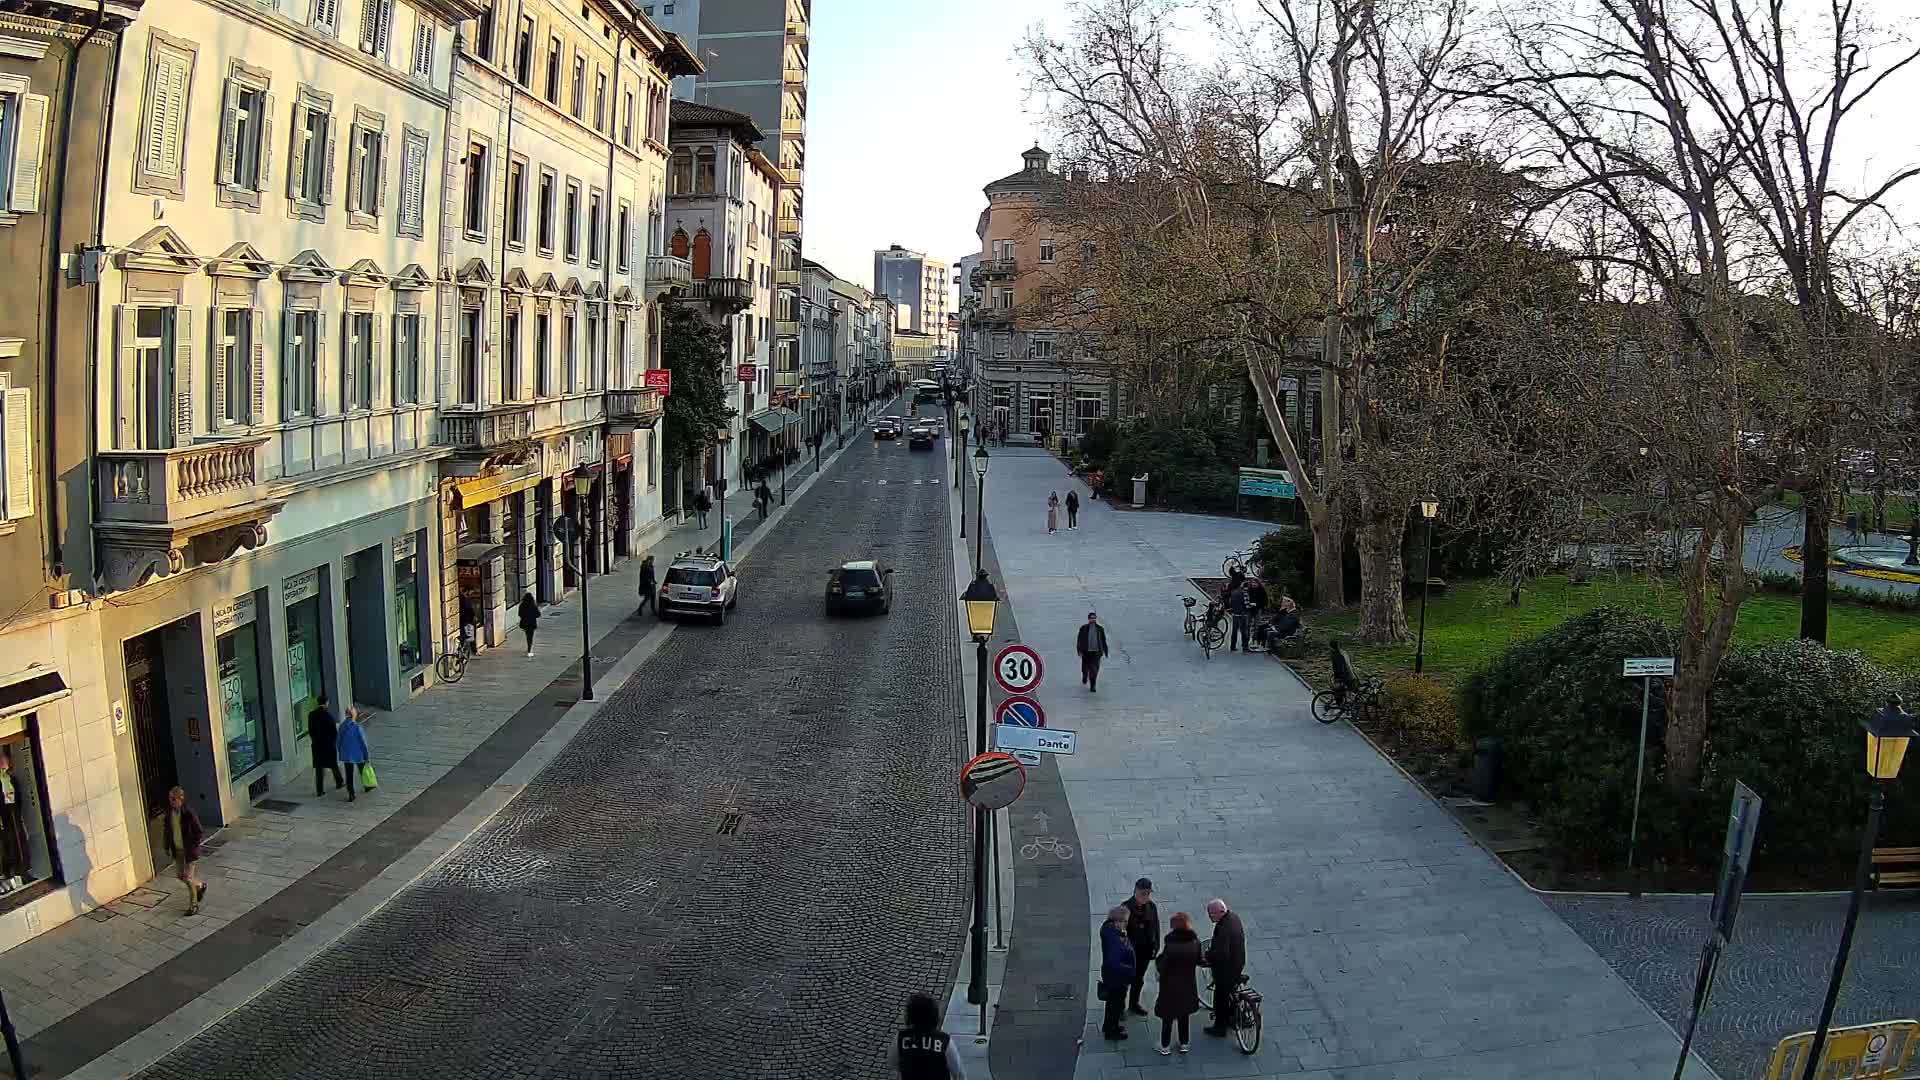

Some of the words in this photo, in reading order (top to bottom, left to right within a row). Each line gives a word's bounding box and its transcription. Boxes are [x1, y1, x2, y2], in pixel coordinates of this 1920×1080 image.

[1005, 658, 1032, 680] 30
[221, 678, 240, 701] 130
[1038, 738, 1069, 750] Dante
